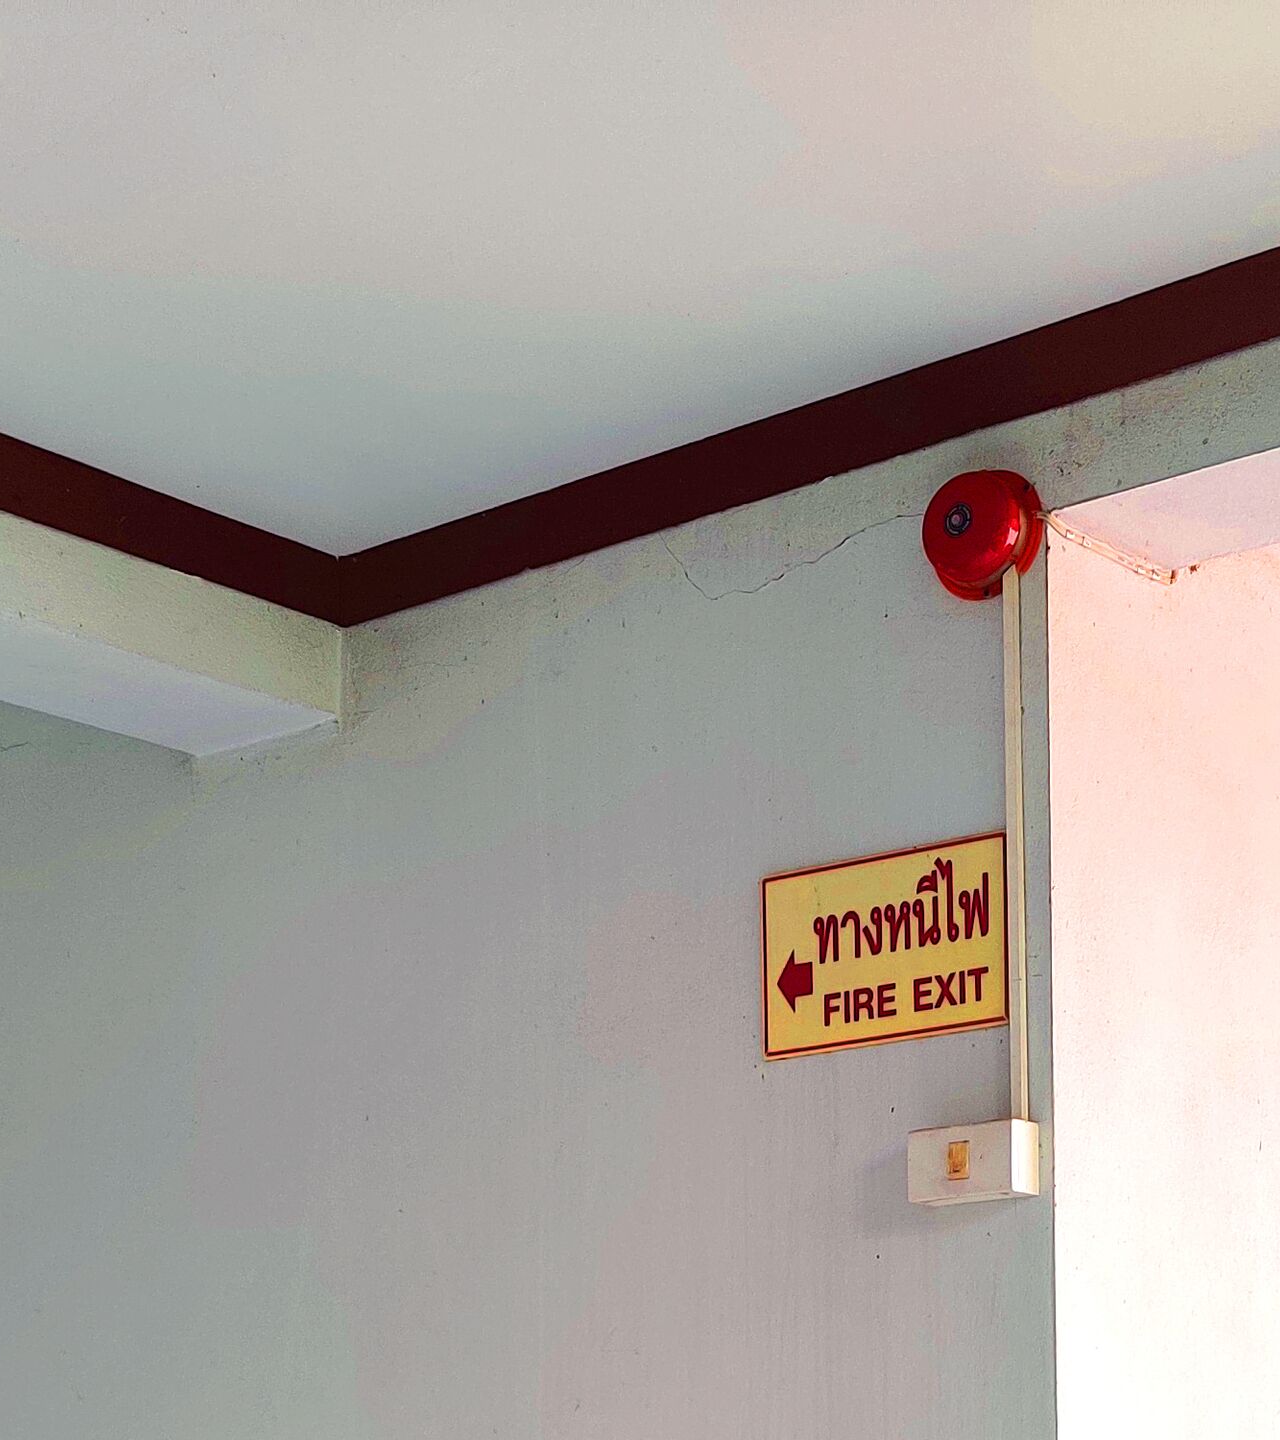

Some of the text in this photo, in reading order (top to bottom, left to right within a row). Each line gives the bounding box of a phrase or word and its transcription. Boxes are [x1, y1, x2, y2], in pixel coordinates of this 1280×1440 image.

[813, 857, 989, 964] ทางหนีไฟ
[823, 966, 989, 1027] FIRE EXIT
